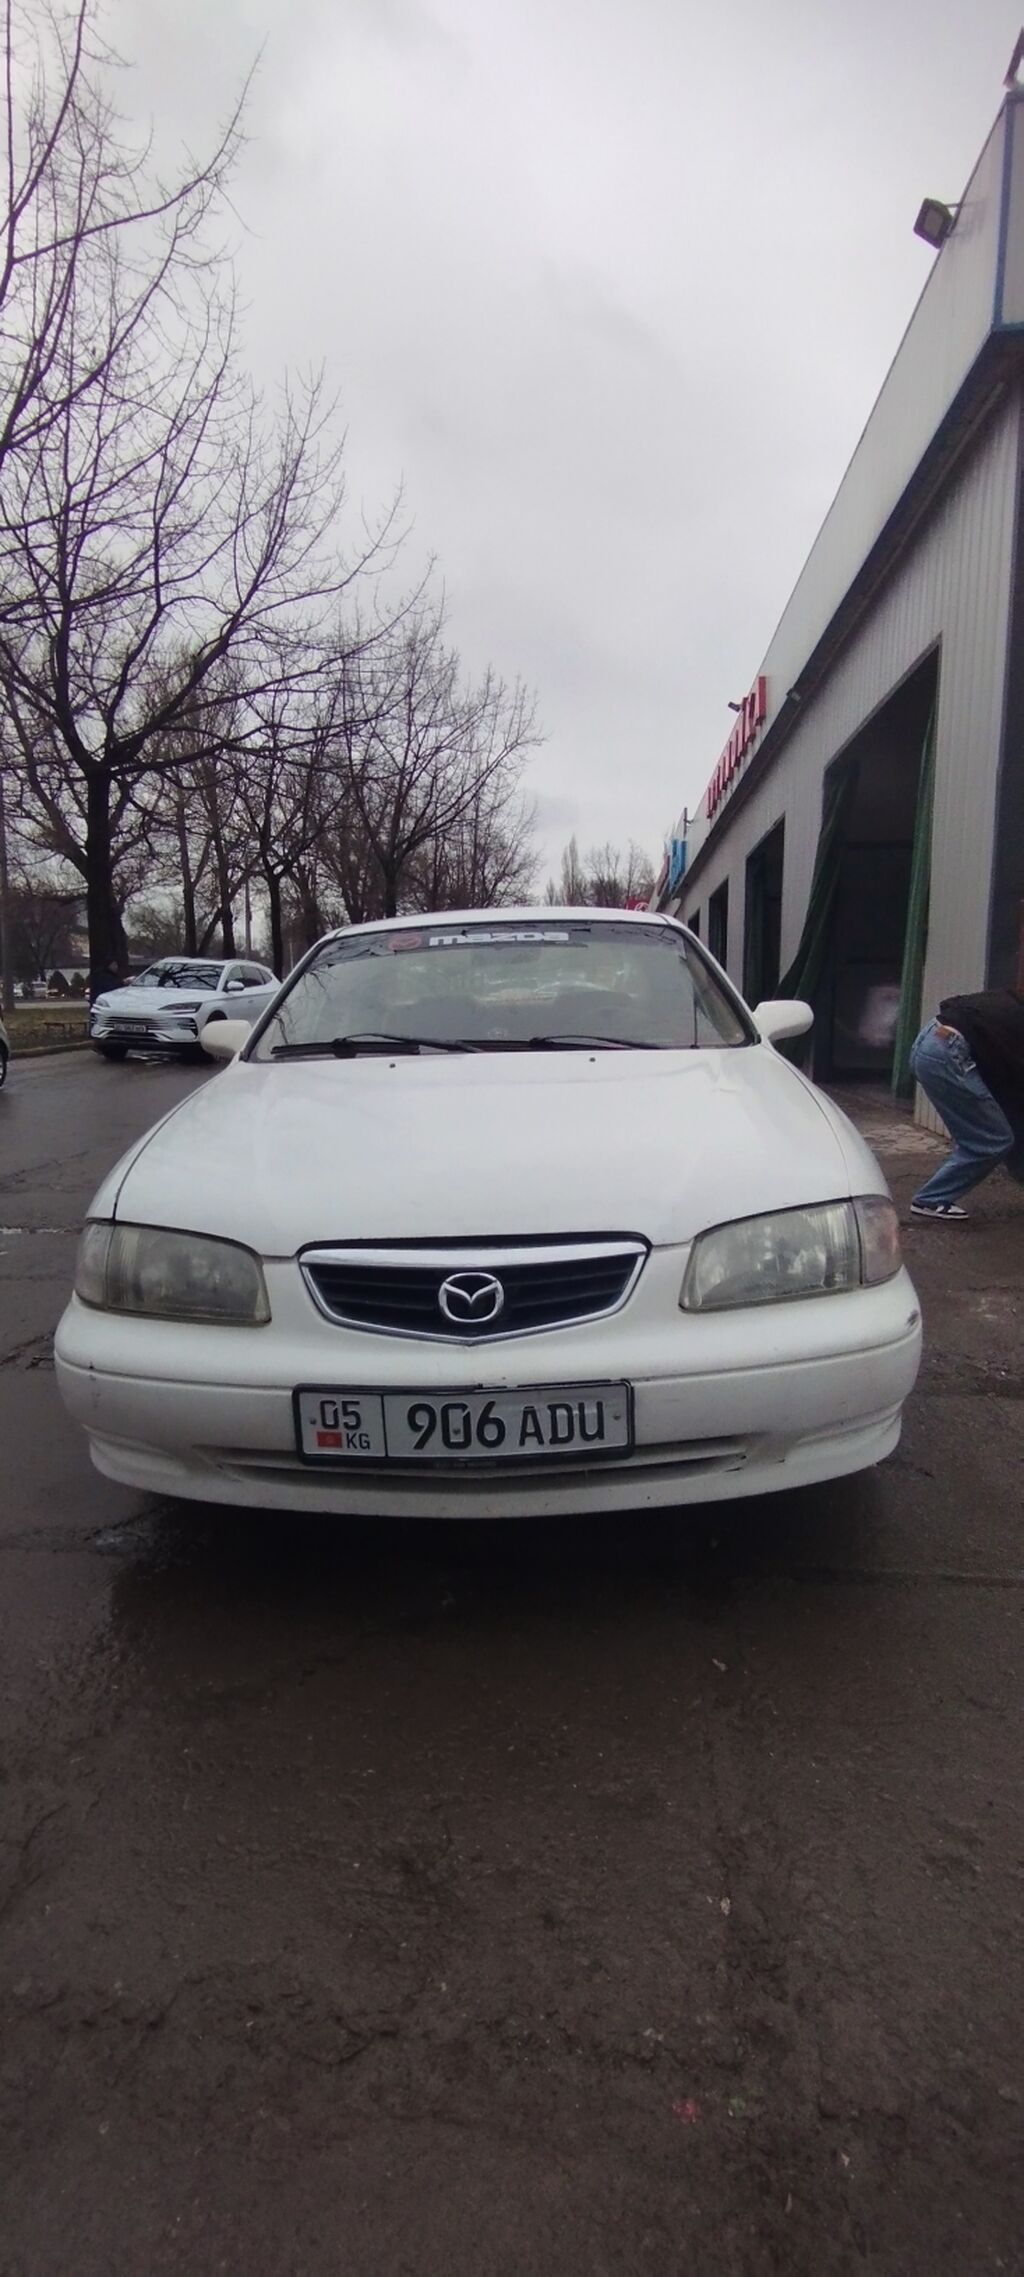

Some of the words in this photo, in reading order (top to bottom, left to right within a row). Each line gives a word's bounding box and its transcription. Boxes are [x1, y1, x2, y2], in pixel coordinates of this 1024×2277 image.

[320, 1400, 361, 1430] 05
[407, 1401, 506, 1450] 906
[518, 1400, 605, 1447] ADU
[346, 1433, 370, 1450] KG
